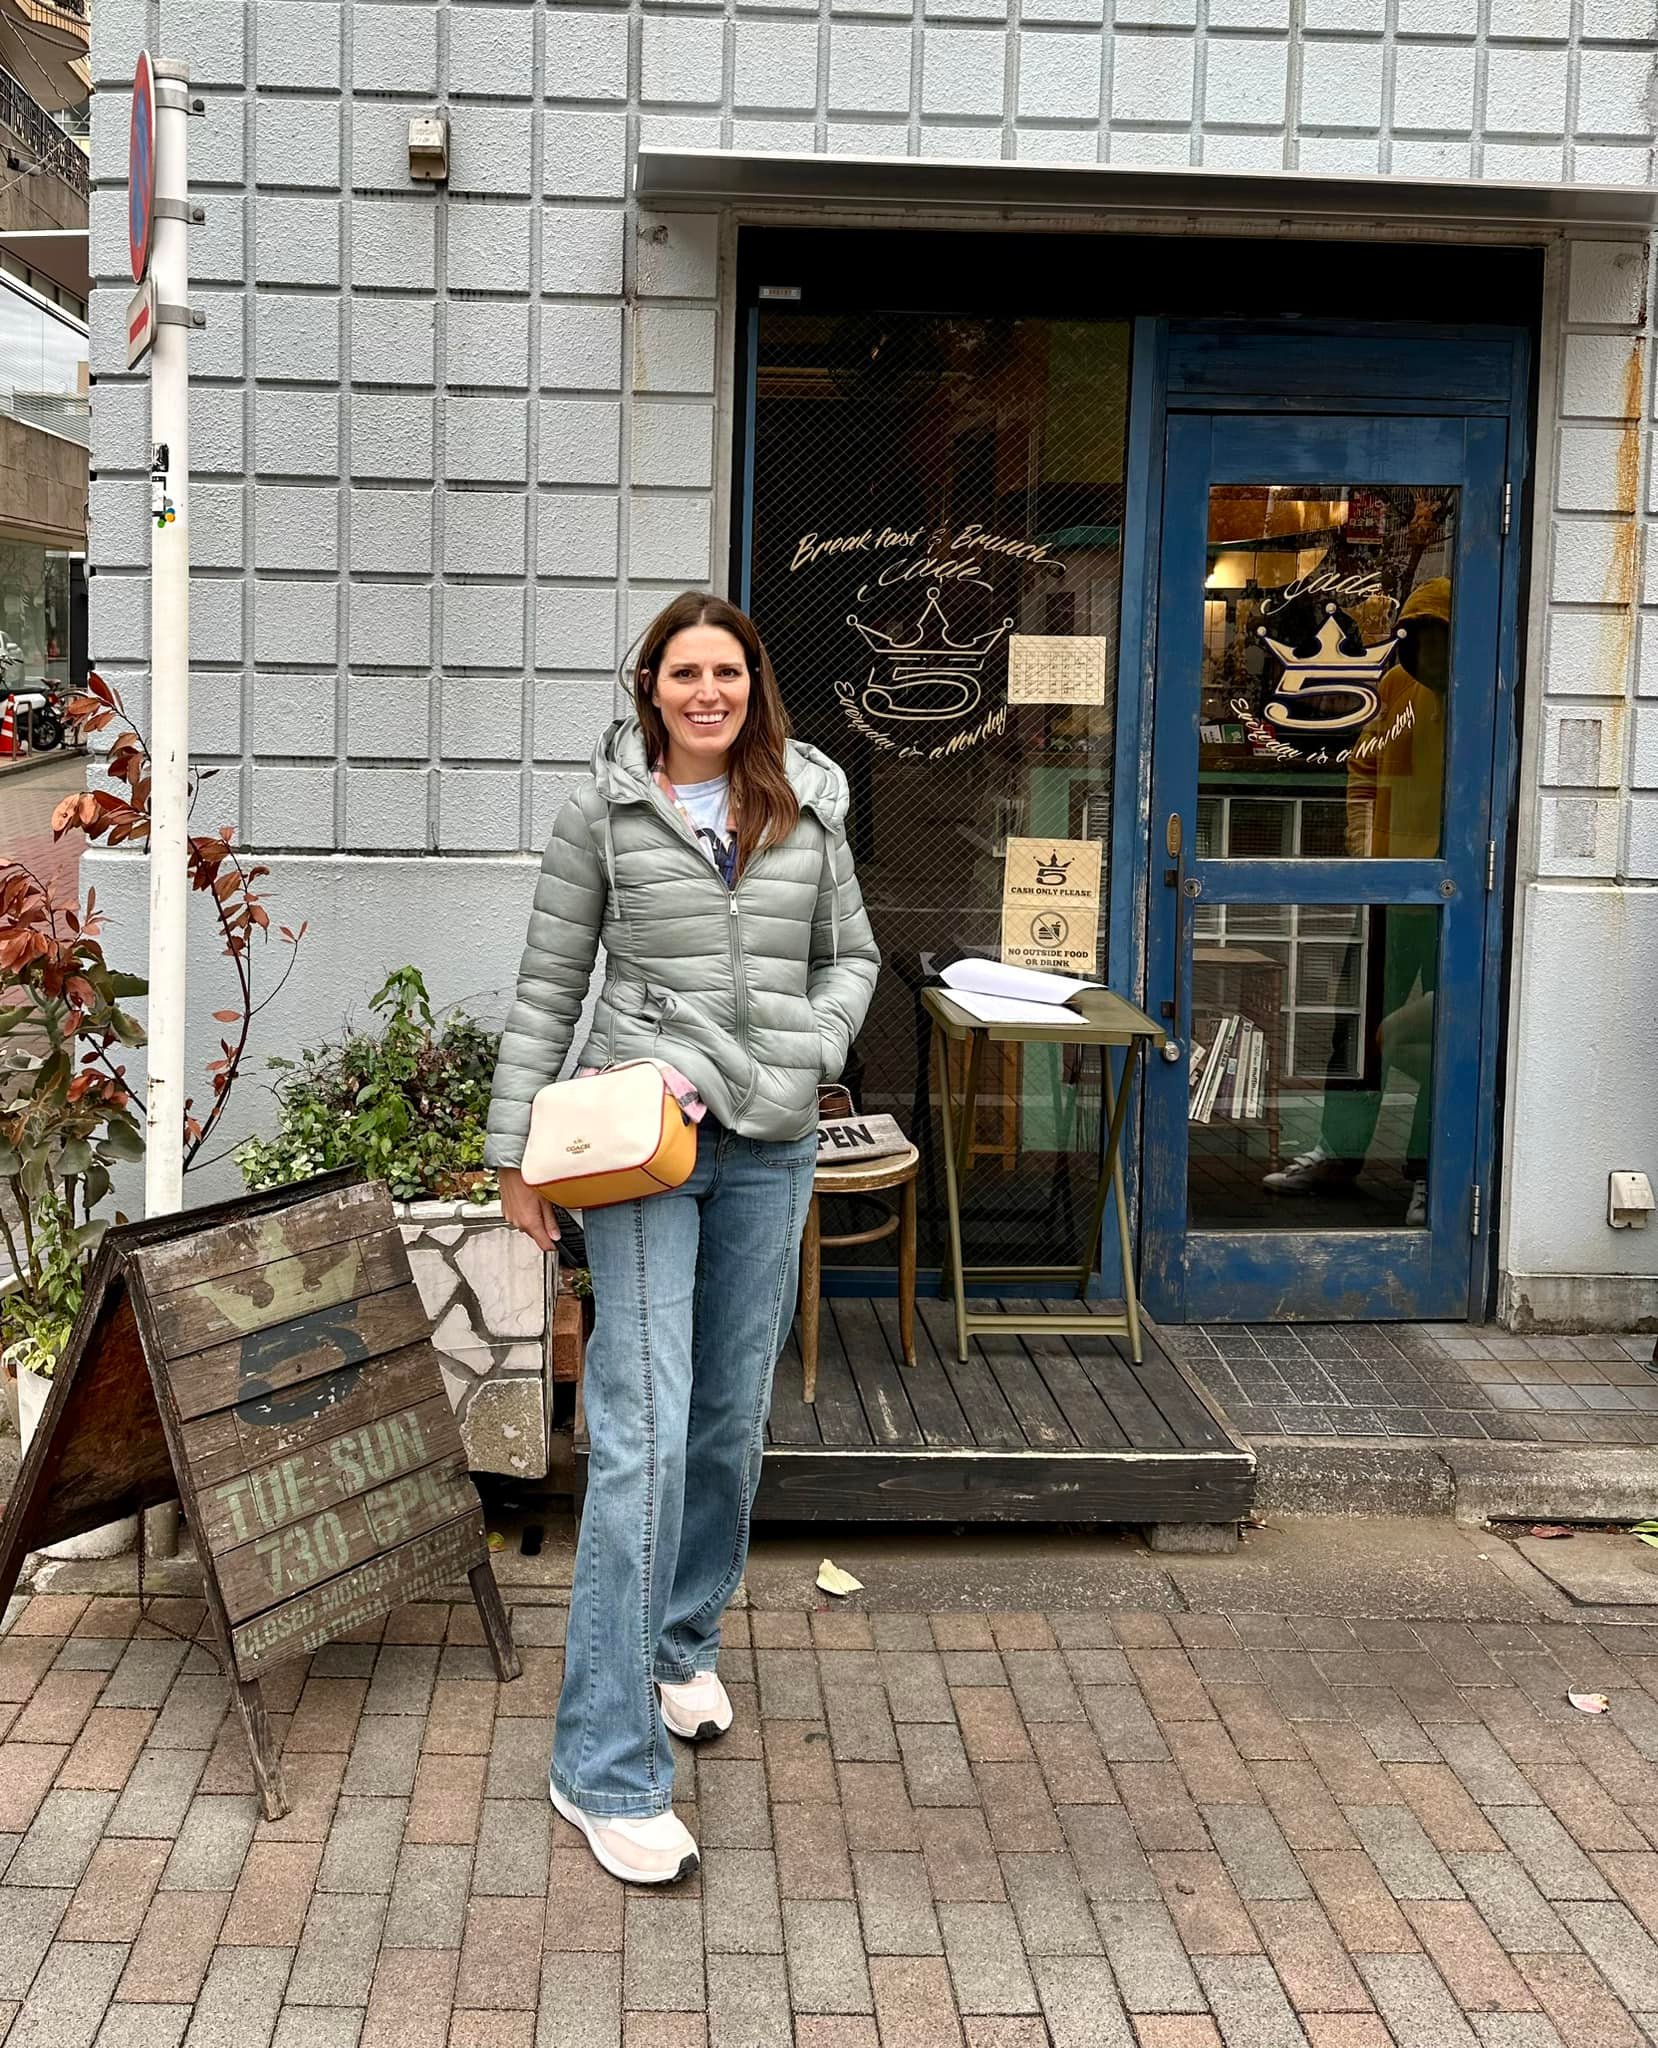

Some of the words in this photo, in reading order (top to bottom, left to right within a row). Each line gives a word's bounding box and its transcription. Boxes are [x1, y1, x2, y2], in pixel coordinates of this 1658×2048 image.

[950, 524, 1067, 571] Brunch
[862, 657, 984, 721] 5
[1263, 668, 1384, 730] 5
[898, 740, 924, 759] is
[929, 746, 945, 760] a
[1306, 746, 1329, 765] is
[1336, 749, 1352, 764] a
[1036, 868, 1067, 885] 5
[1011, 887, 1035, 895] CASH
[1036, 887, 1058, 896] ONLY
[1059, 888, 1091, 897] PLEASE
[1008, 948, 1021, 956] NO
[1023, 949, 1062, 957] OUTSIDE
[1025, 958, 1038, 966] OR
[1040, 959, 1070, 967] DRINK
[816, 1123, 876, 1151] PEN
[236, 1300, 370, 1426] 5
[215, 1410, 427, 1542] TUE-SUN
[237, 1602, 317, 1657] CLOSED
